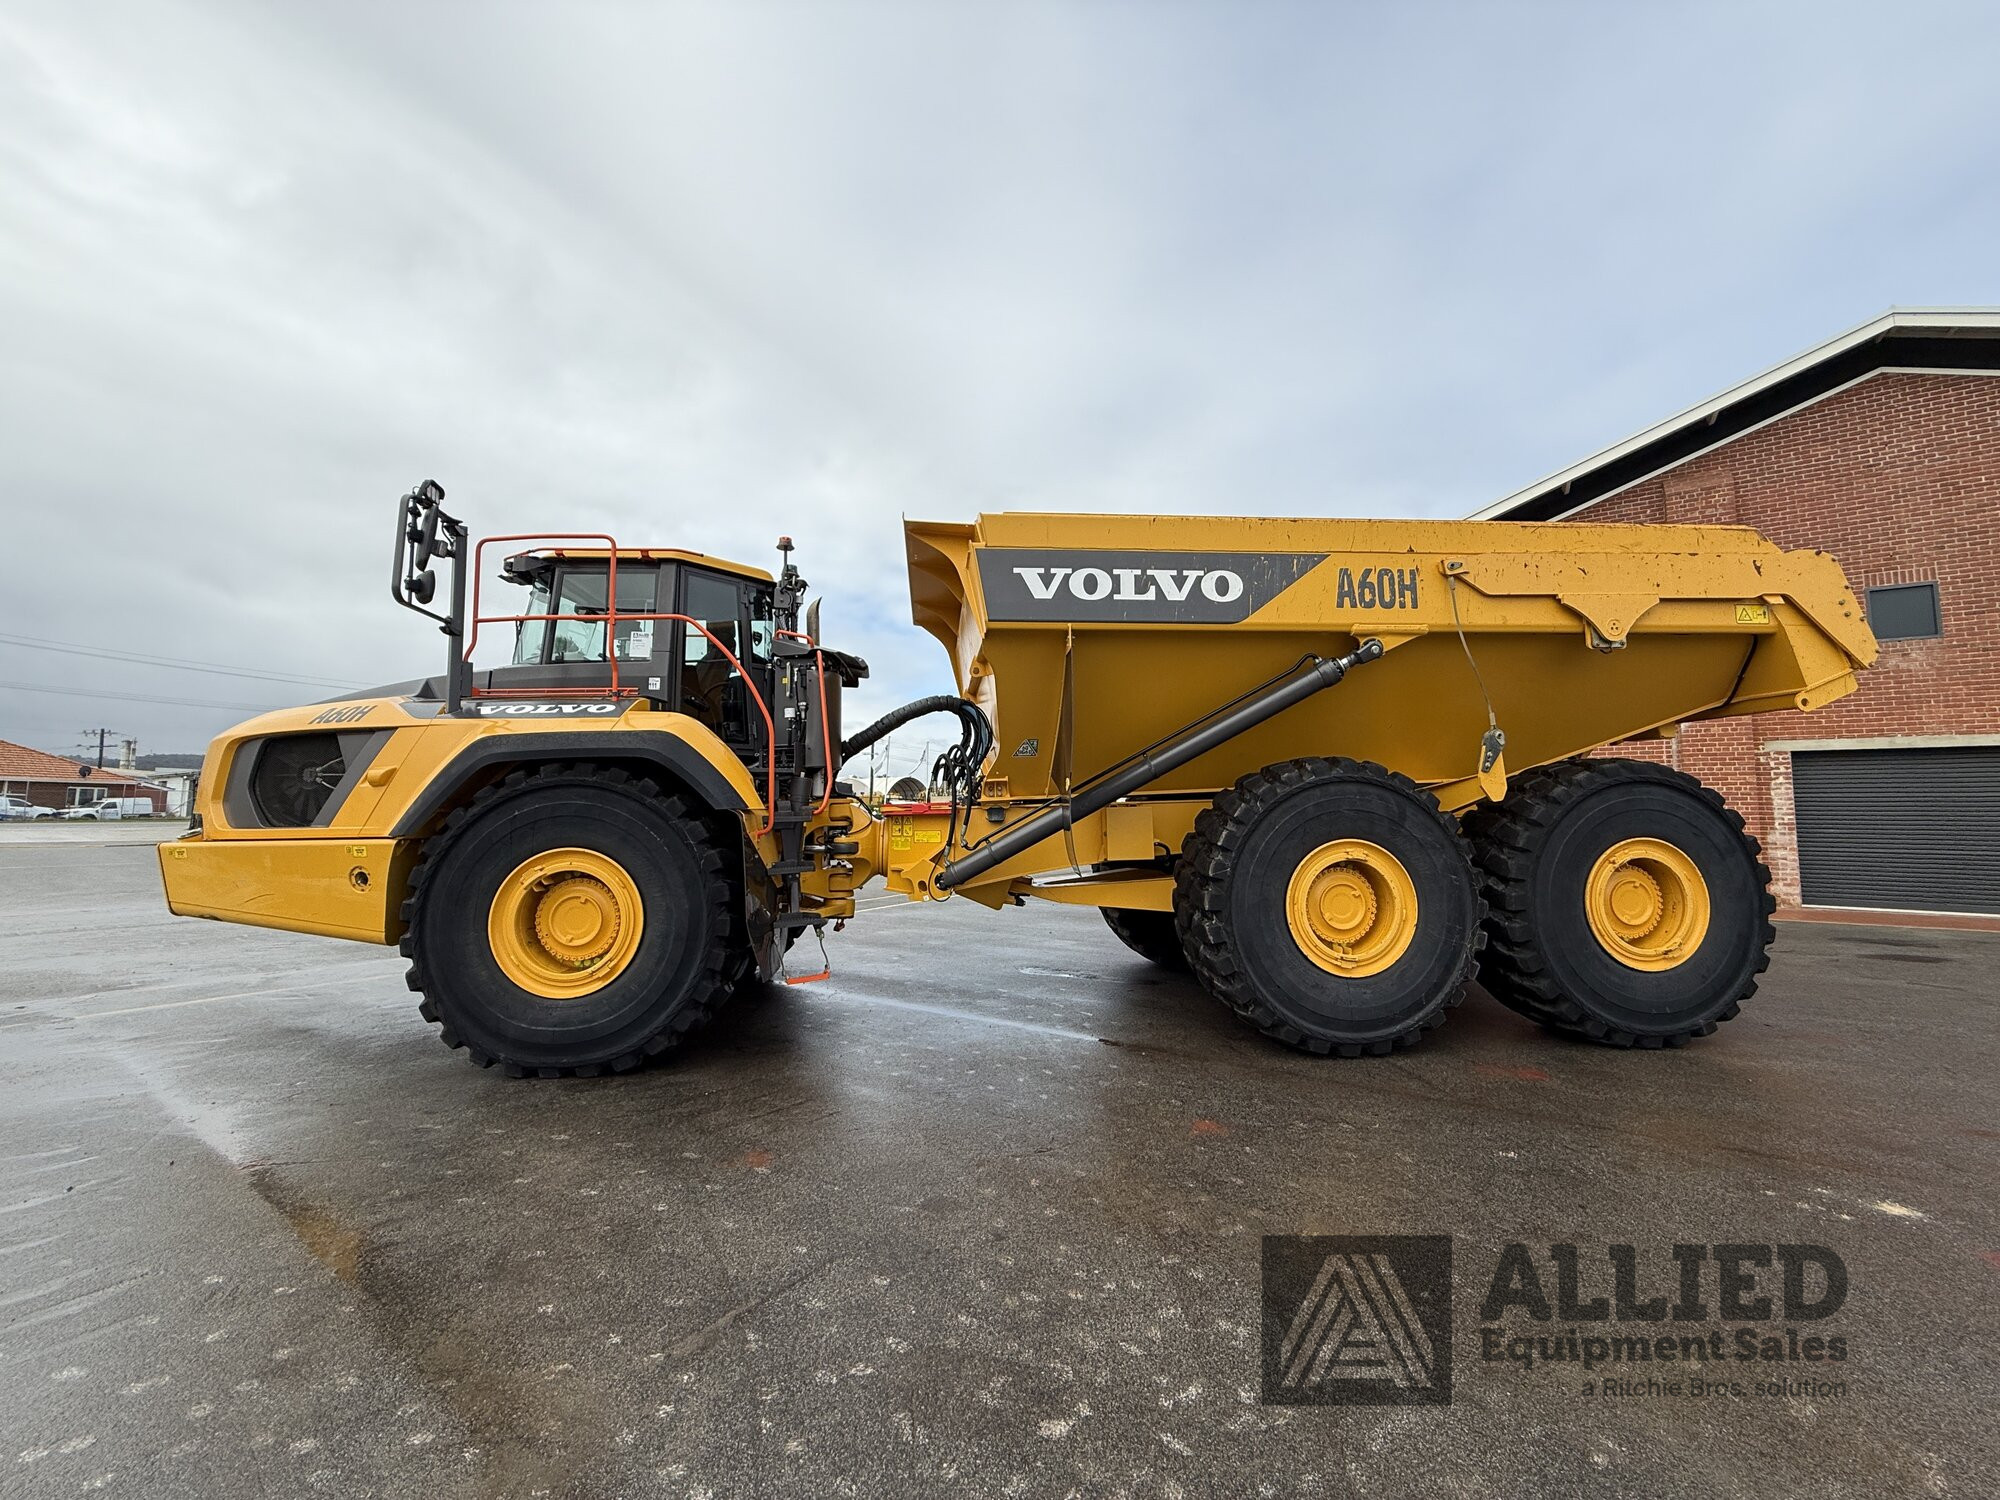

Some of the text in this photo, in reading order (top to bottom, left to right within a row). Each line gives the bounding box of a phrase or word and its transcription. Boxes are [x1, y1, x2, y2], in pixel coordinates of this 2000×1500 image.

[1013, 567, 1244, 602] VOLVO
[1335, 567, 1419, 610] A60H
[308, 704, 378, 725] A60H
[476, 703, 617, 716] VOLVO
